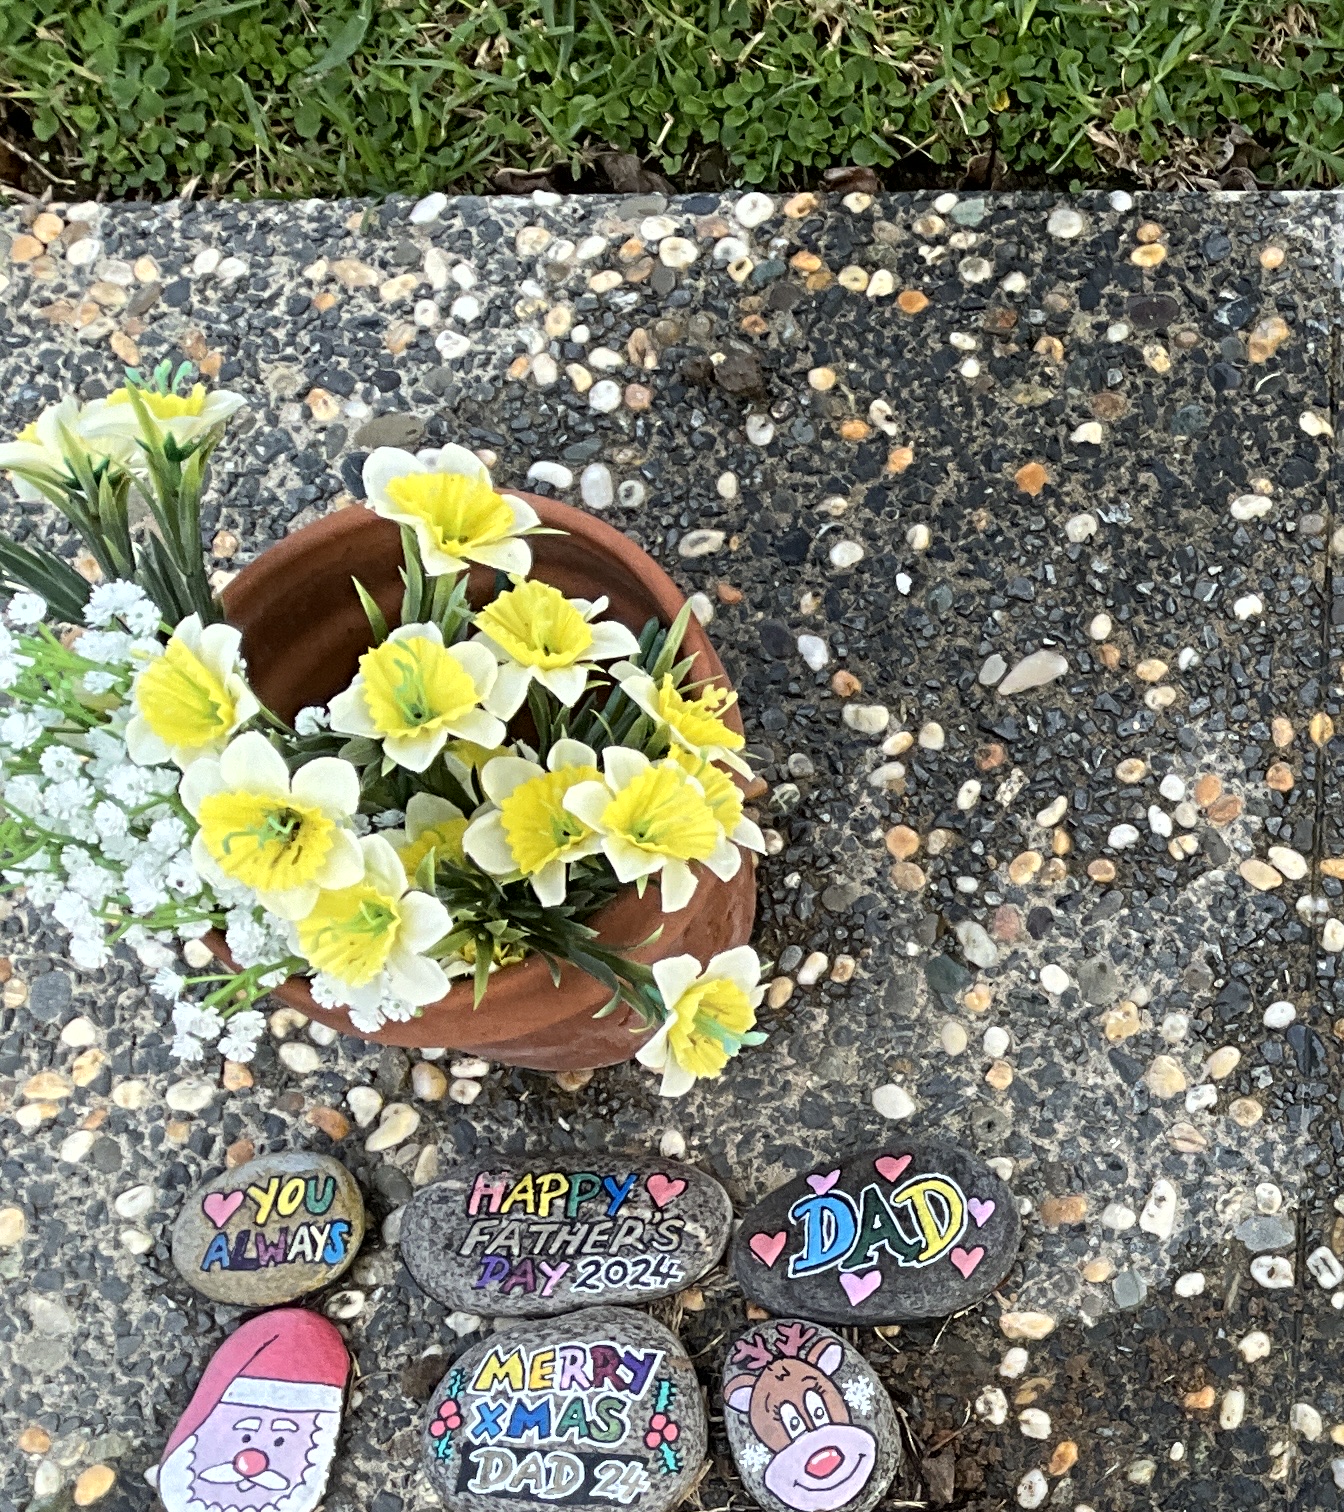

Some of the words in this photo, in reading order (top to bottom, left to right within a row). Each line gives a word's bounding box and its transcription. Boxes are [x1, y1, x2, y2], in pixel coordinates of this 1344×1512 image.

[246, 1175, 336, 1227] YOU
[466, 1170, 640, 1218] HAPPY
[201, 1218, 352, 1271] ALWAYS
[458, 1212, 687, 1256] FATHER'S
[788, 1171, 972, 1278] DAD
[472, 1254, 570, 1297] DAY
[570, 1254, 686, 1292] 2024
[467, 1342, 666, 1400] MERRY
[466, 1392, 631, 1447] XMAS
[467, 1447, 585, 1499] DAD
[590, 1460, 650, 1503] 24
